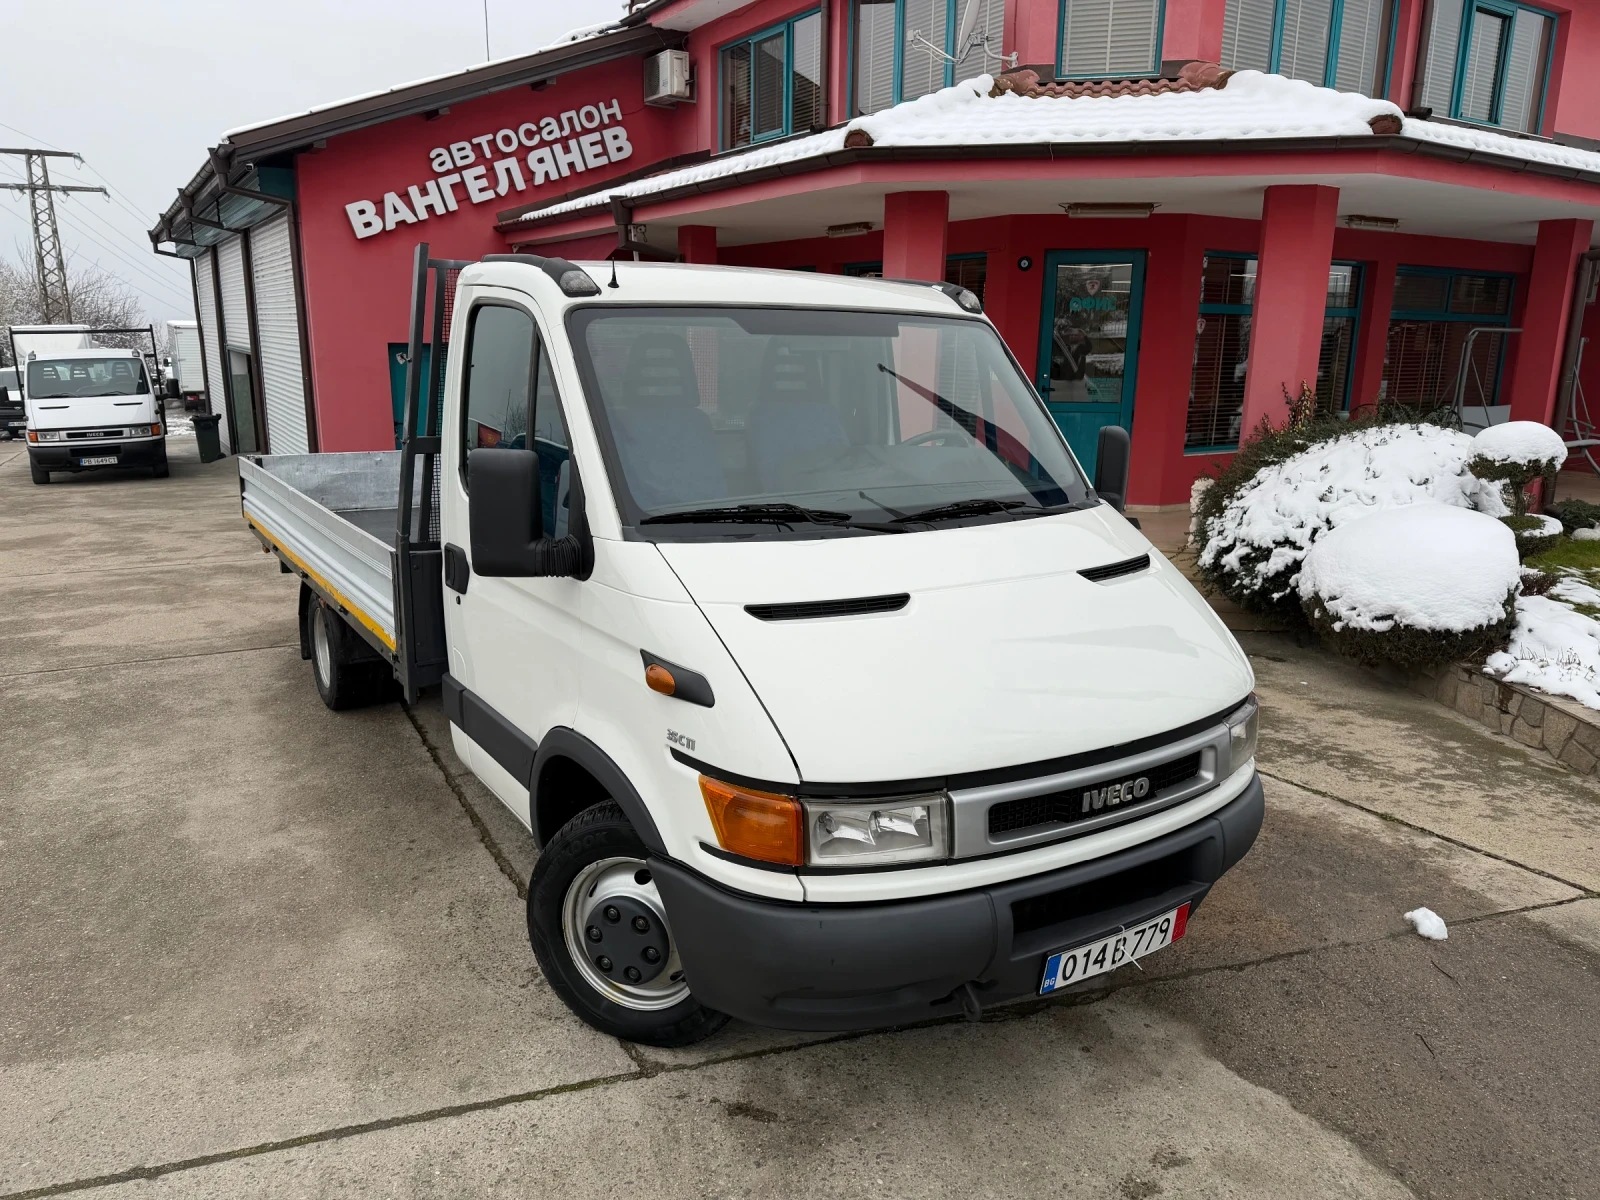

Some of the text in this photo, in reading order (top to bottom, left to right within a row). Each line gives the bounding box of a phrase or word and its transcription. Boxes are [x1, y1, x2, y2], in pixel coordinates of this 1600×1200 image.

[429, 98, 623, 173] автосалон
[344, 125, 633, 240] ВАНГЕЛ ЯНЕВ
[1081, 777, 1150, 812] IVECO
[1044, 977, 1055, 988] BG
